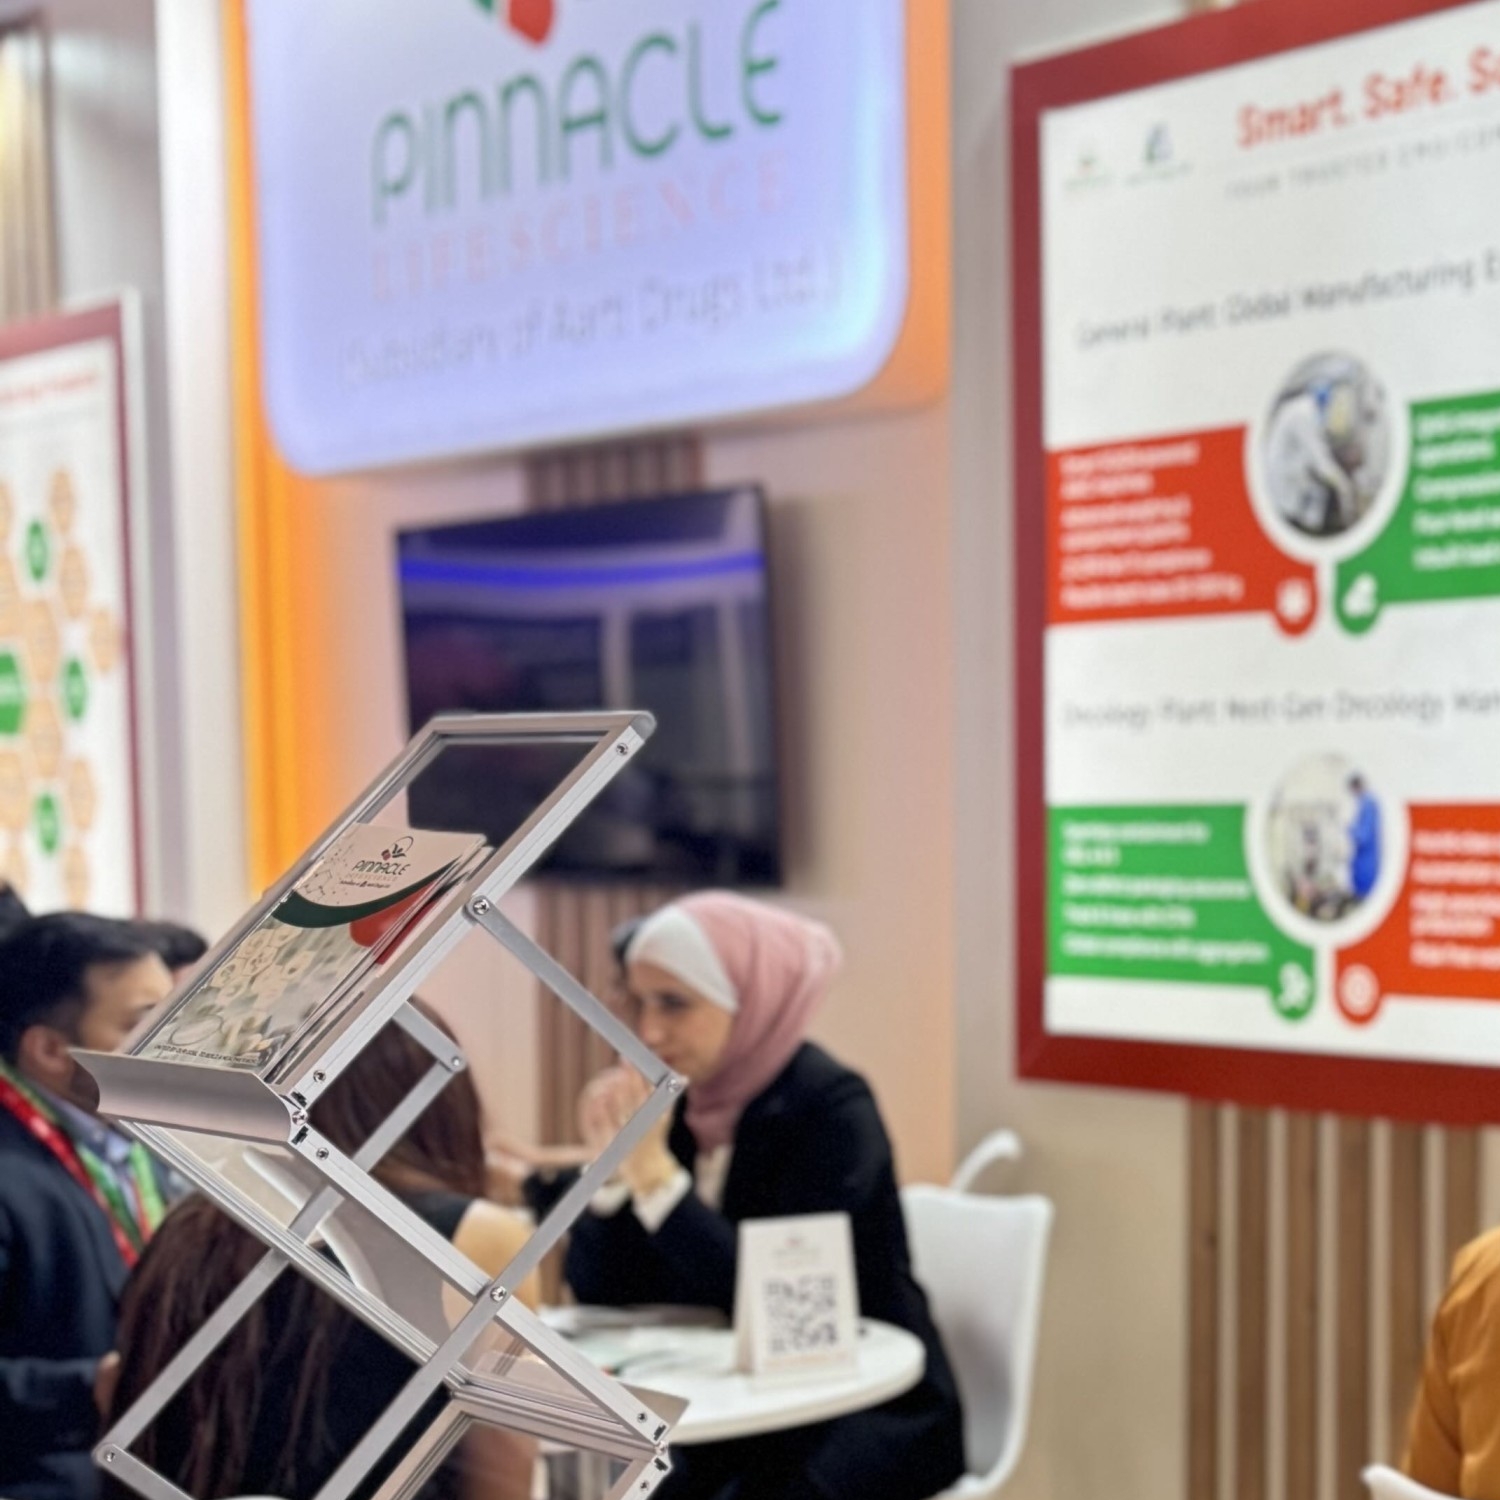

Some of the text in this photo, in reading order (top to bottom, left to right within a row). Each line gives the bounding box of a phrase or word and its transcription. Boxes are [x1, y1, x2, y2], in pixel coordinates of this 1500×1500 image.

[370, 0, 786, 226] PINNACLE
[1238, 88, 1354, 149] Smart.
[1364, 62, 1458, 118] Safe.
[1302, 256, 1474, 311] Manufacturing
[352, 859, 412, 876] PINNACLE
